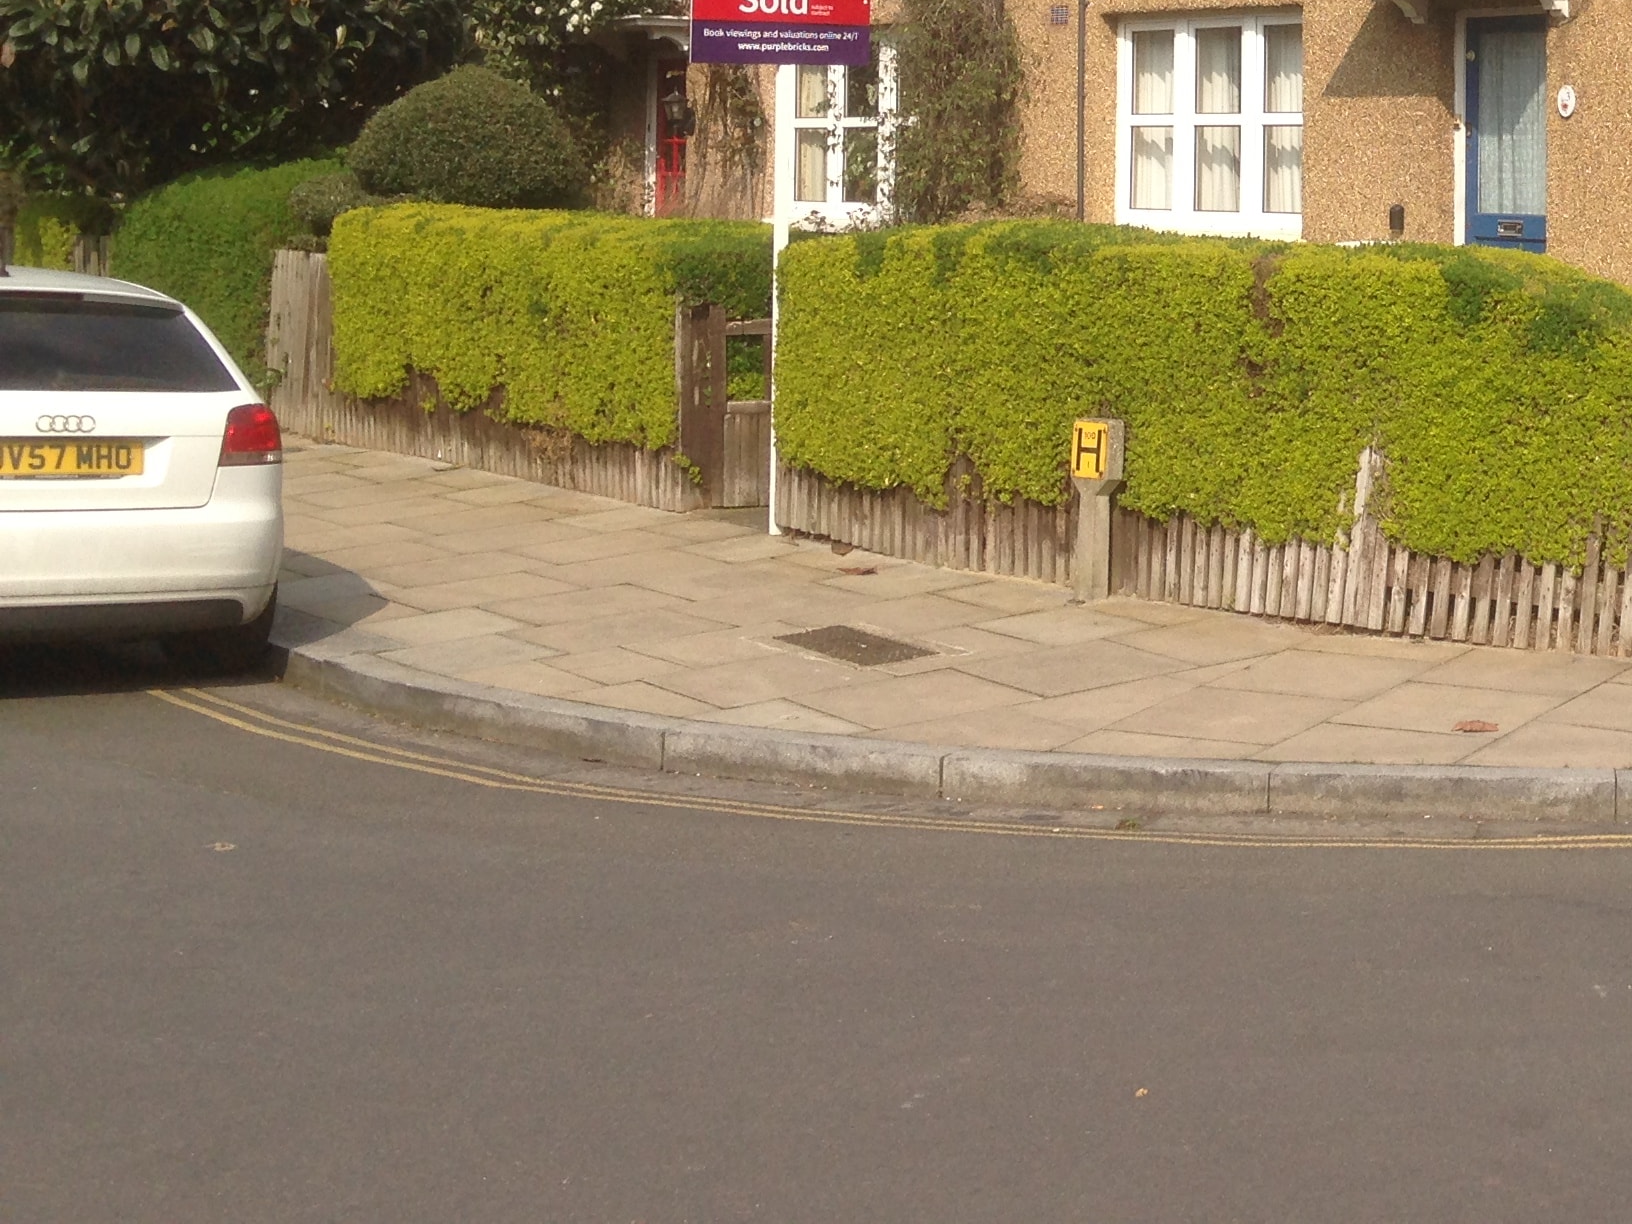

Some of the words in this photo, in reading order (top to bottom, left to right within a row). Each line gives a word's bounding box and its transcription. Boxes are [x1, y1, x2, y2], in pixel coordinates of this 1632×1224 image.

[703, 28, 724, 37] Book
[726, 28, 761, 40] viewings
[763, 30, 778, 38] and
[780, 30, 818, 40] valuations
[820, 31, 841, 40] online
[842, 32, 858, 42] 24/7
[738, 42, 829, 53] www.purplebricks.com
[76, 445, 131, 470] MHO
[1076, 427, 1102, 473] H
